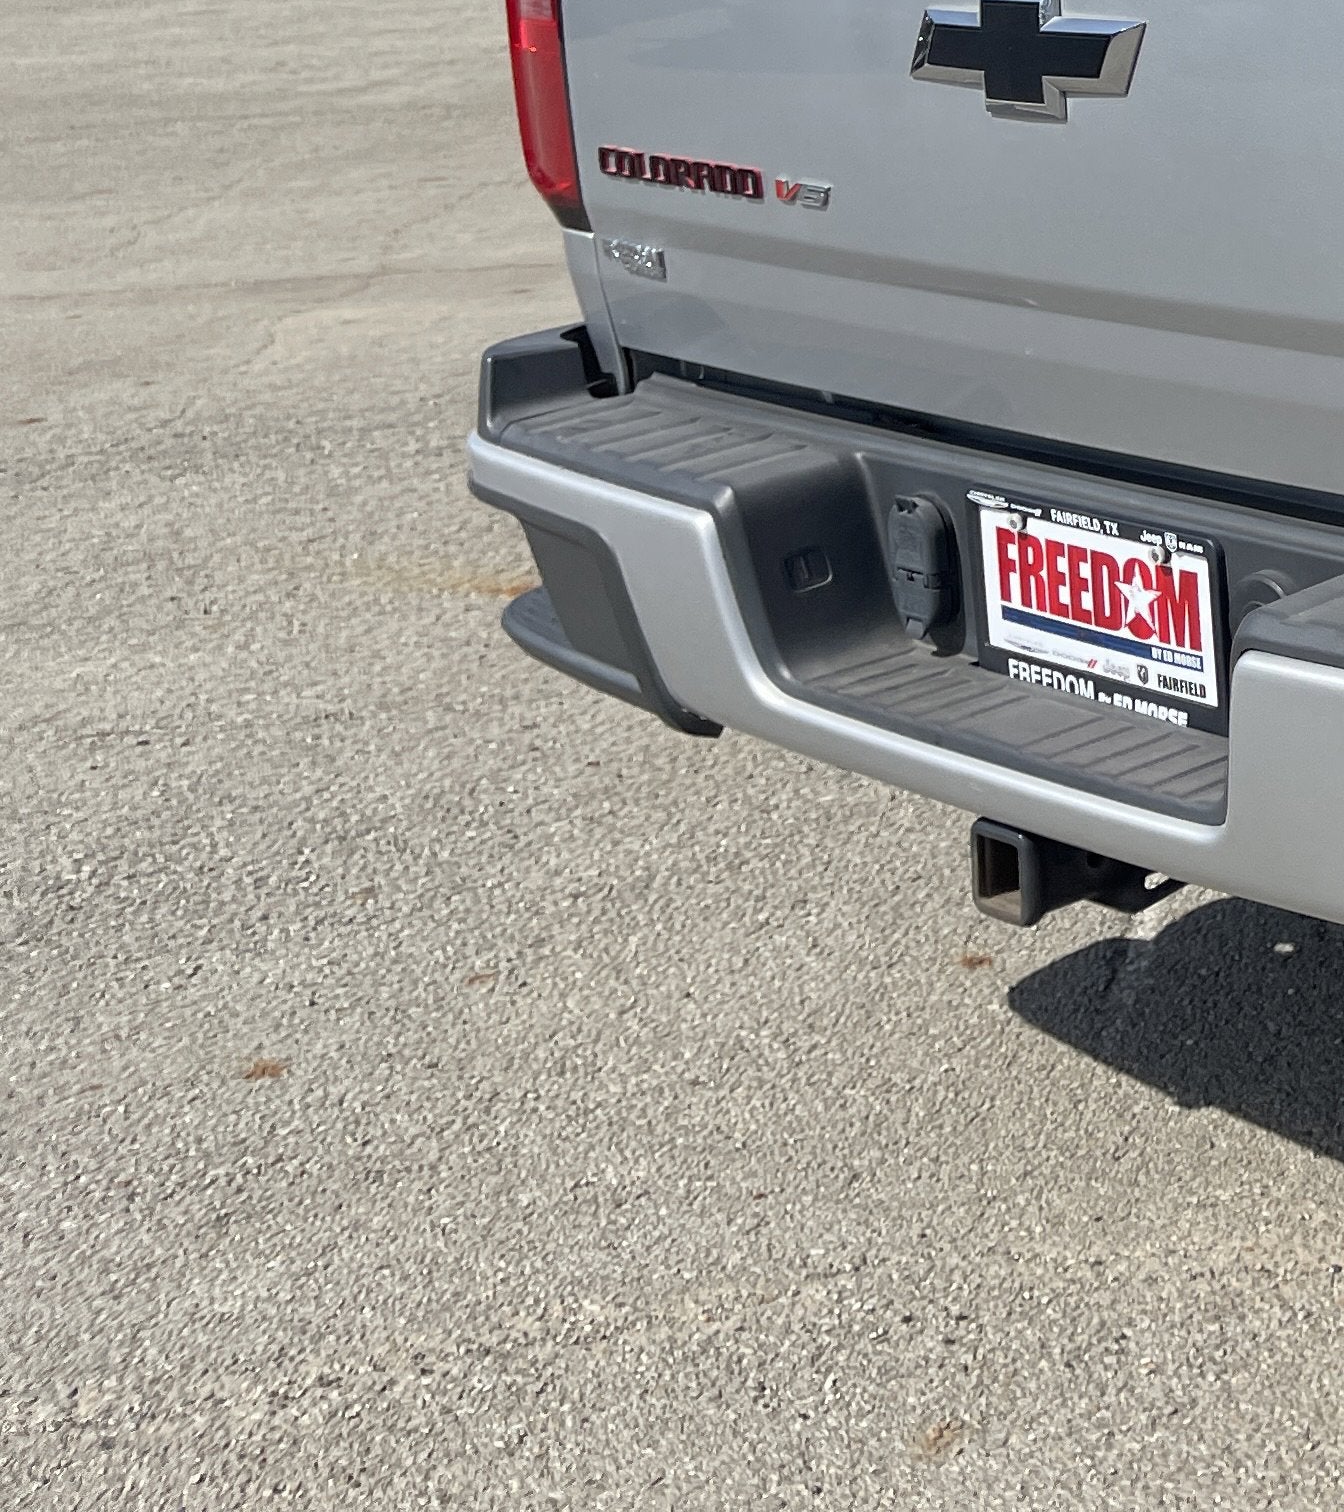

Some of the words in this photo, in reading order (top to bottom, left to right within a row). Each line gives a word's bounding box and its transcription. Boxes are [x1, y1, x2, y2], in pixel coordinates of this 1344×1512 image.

[598, 144, 766, 200] COLORADO
[774, 174, 831, 208] V6
[996, 526, 1203, 652] FREEDOM
[1008, 658, 1095, 700] FREEDOM
[1156, 673, 1207, 699] FAIRFIELD
